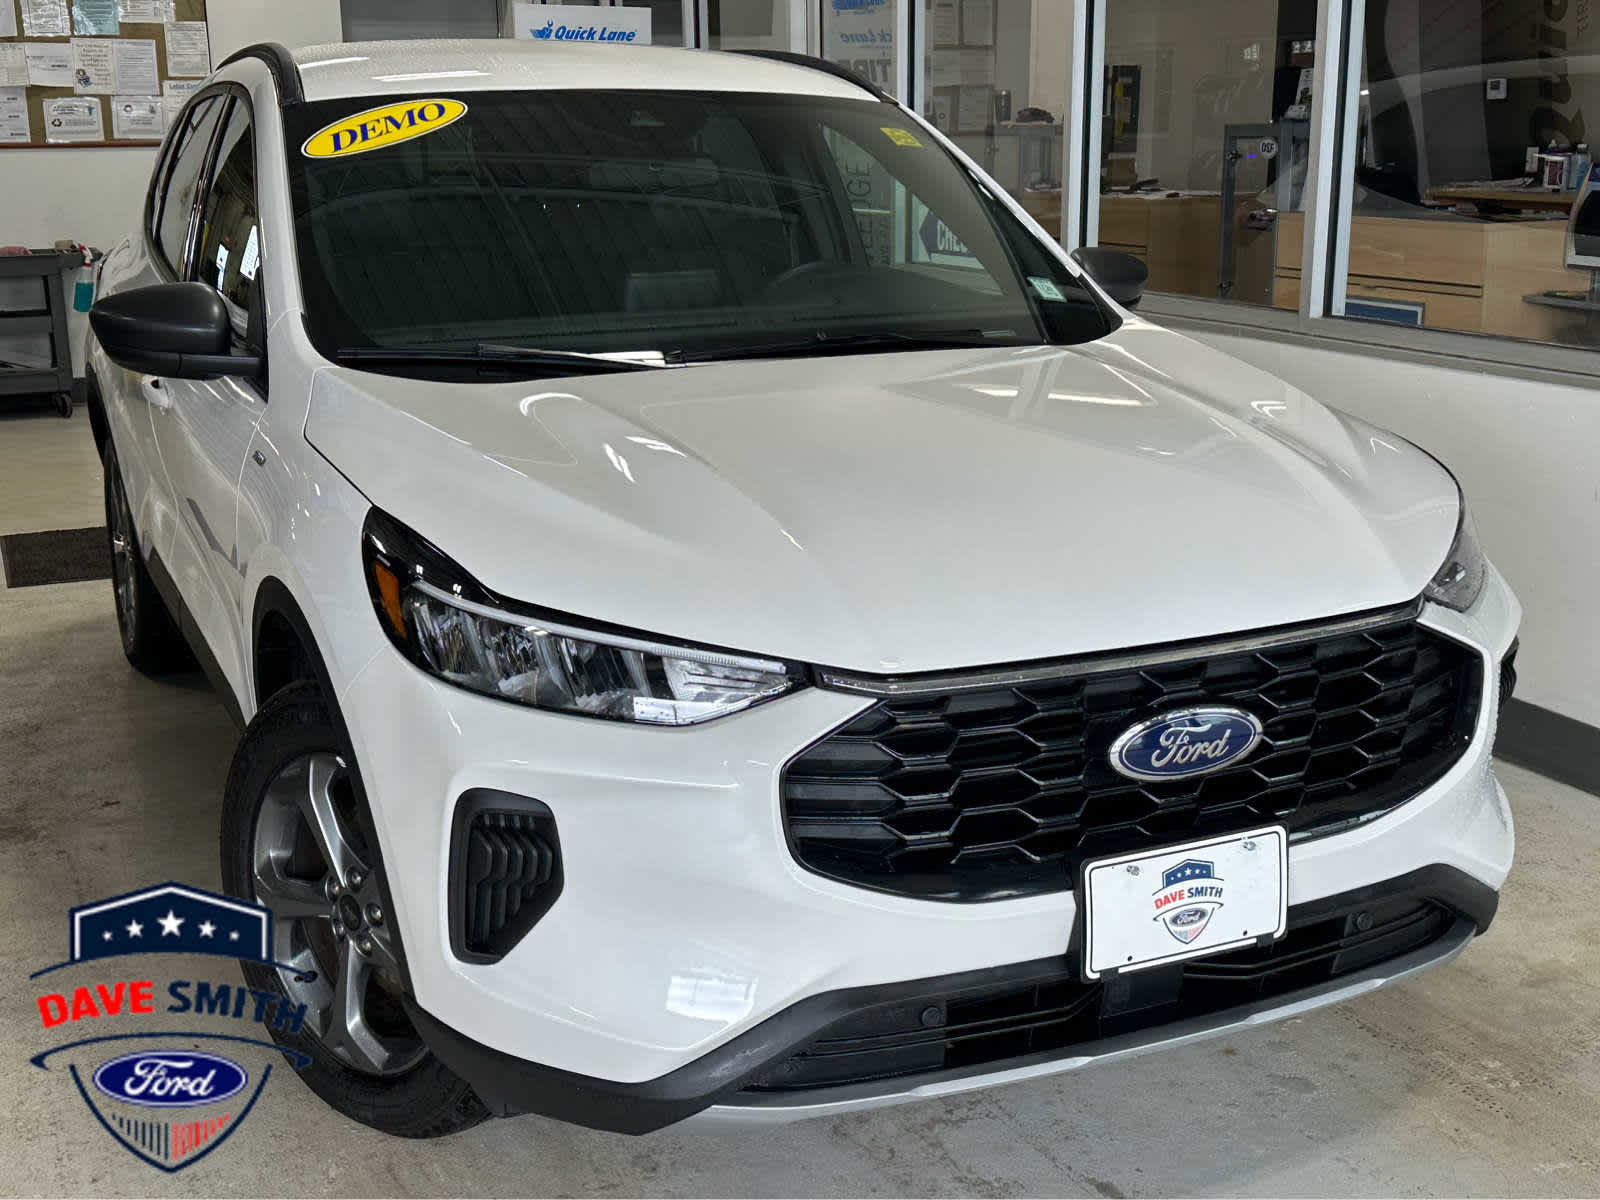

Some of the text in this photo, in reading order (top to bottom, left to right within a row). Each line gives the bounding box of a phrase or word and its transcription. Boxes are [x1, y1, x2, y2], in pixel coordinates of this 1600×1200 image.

[554, 25, 636, 42] Quick Lane
[331, 103, 446, 153] DEMO
[1151, 723, 1232, 768] Ford
[1154, 886, 1223, 910] DAVE SMITH
